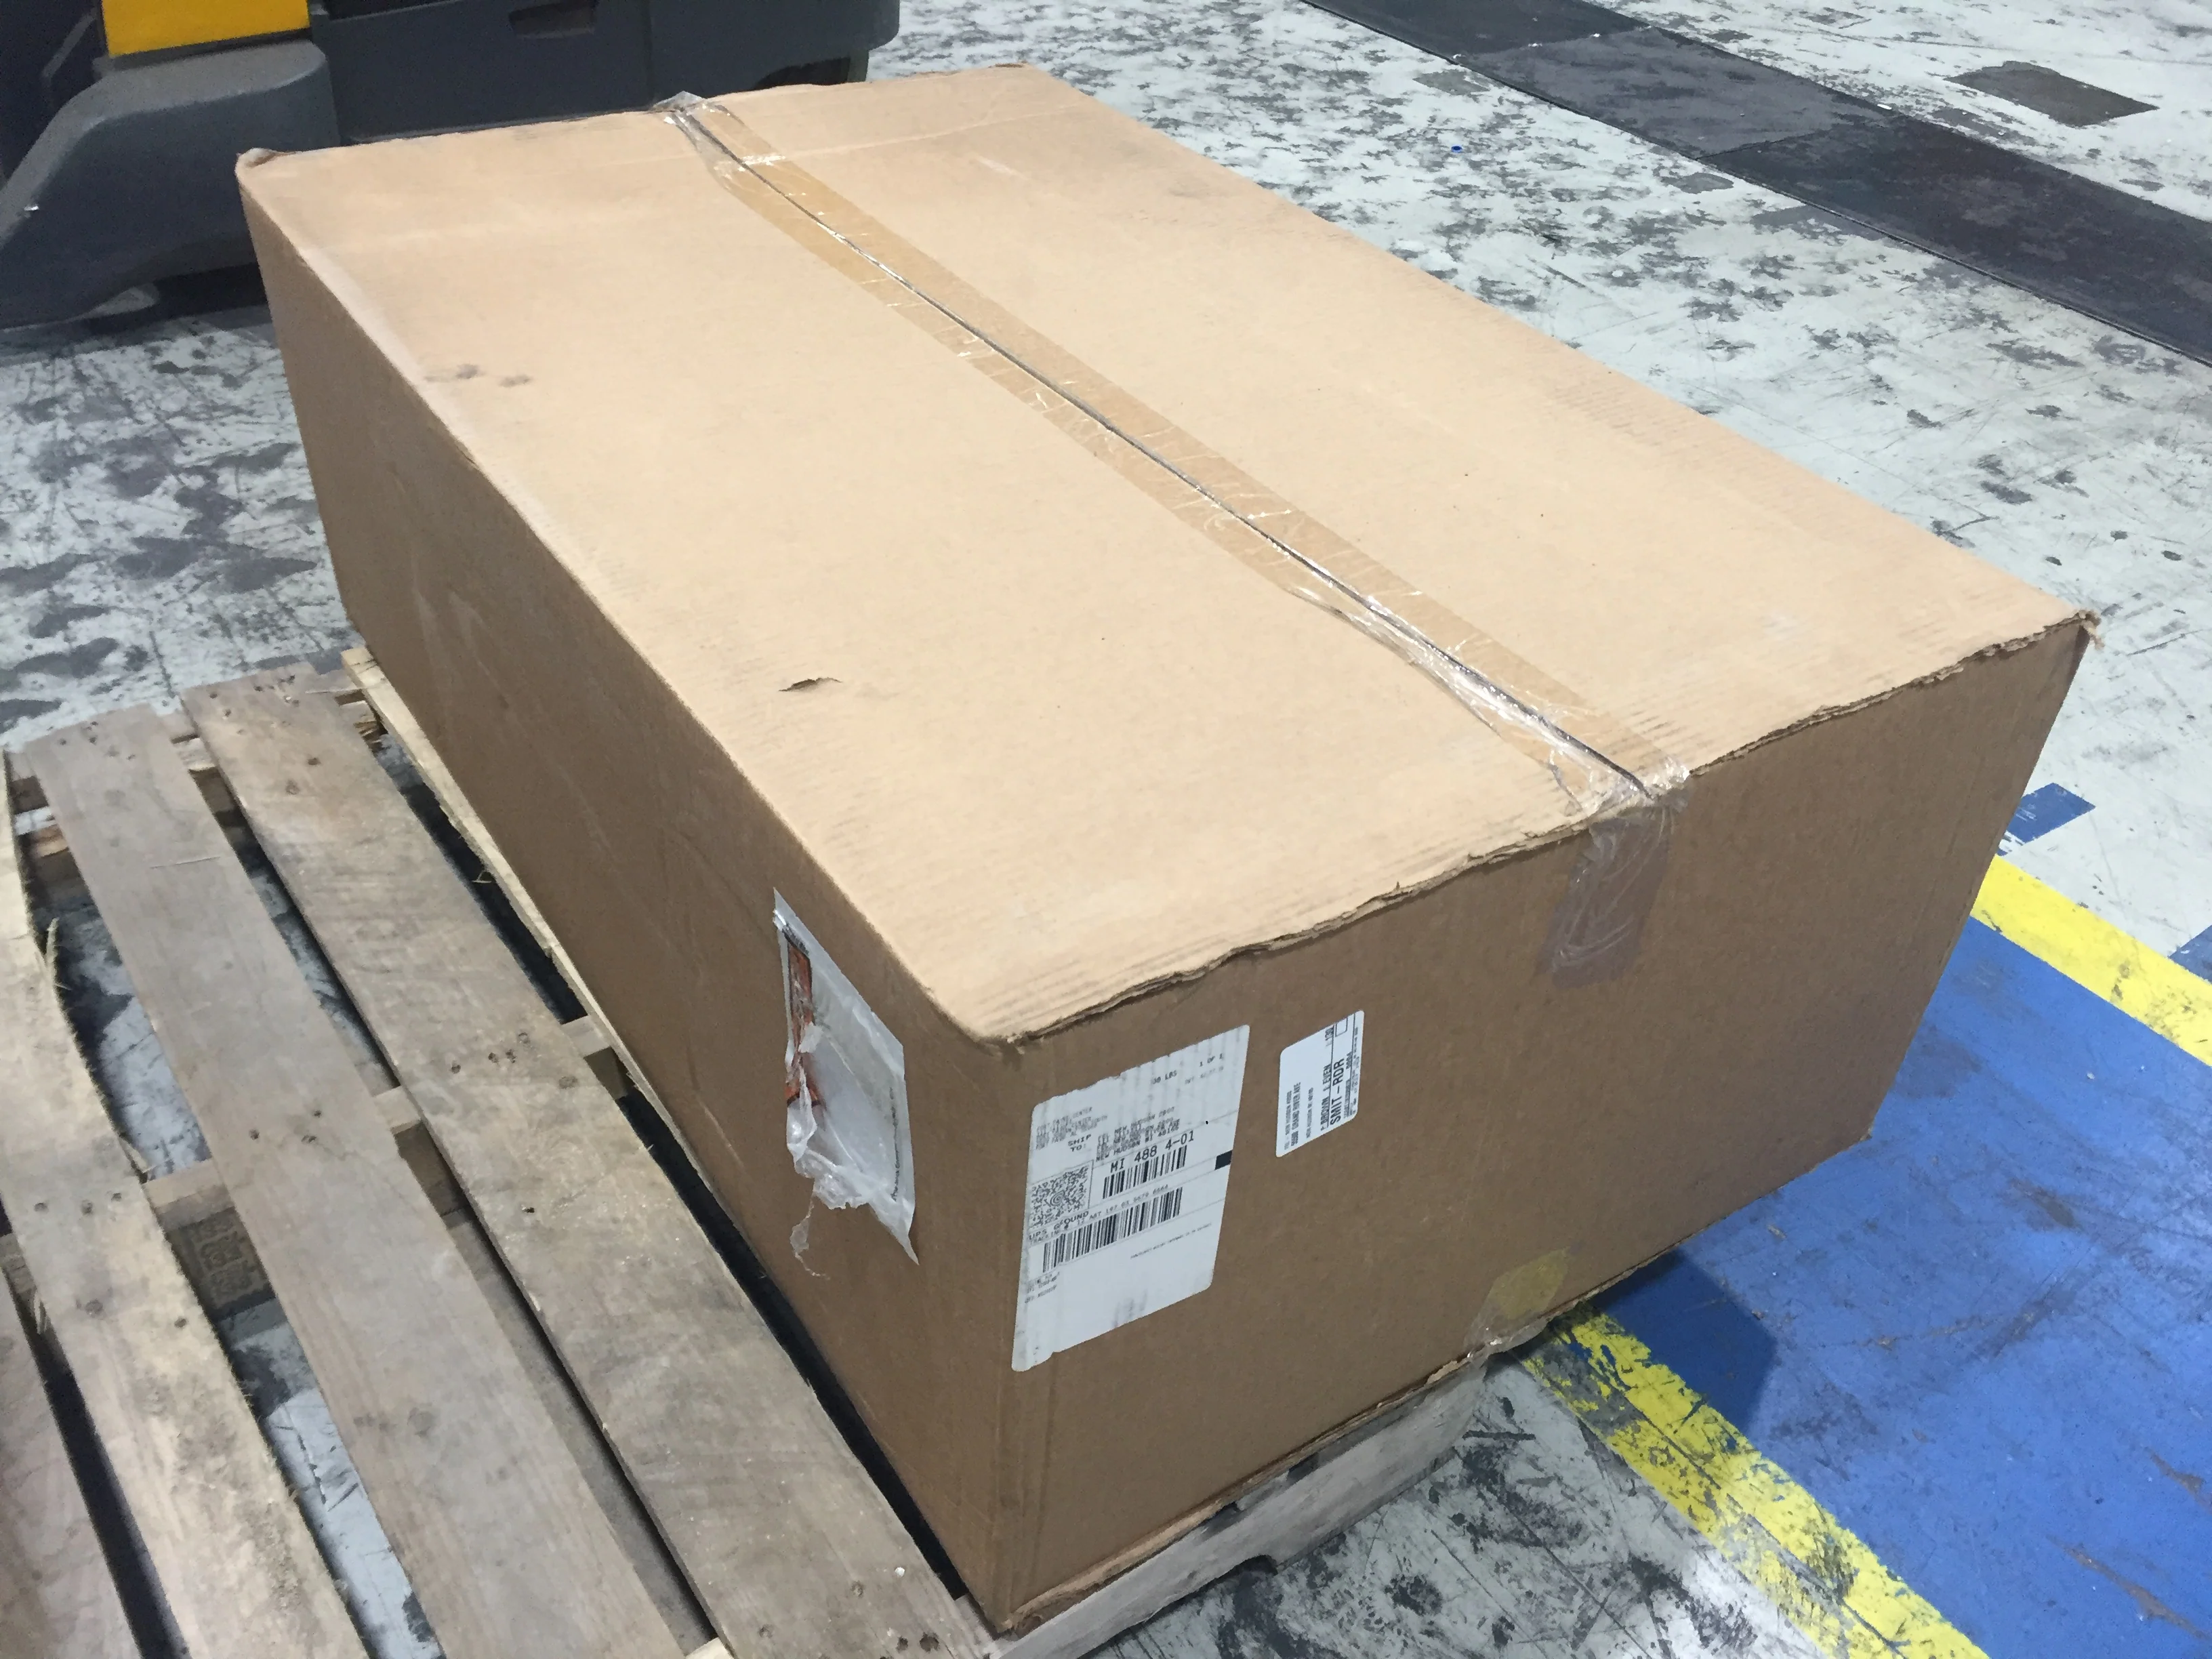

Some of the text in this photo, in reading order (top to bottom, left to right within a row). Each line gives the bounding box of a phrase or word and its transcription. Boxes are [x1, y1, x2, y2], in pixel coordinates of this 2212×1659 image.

[1321, 1096, 1330, 1124] BROWN
[1068, 1134, 1091, 1146] SHIP
[1111, 1158, 1124, 1173] MI
[1134, 1145, 1157, 1162] 488
[1029, 1229, 1047, 1240] UPS
